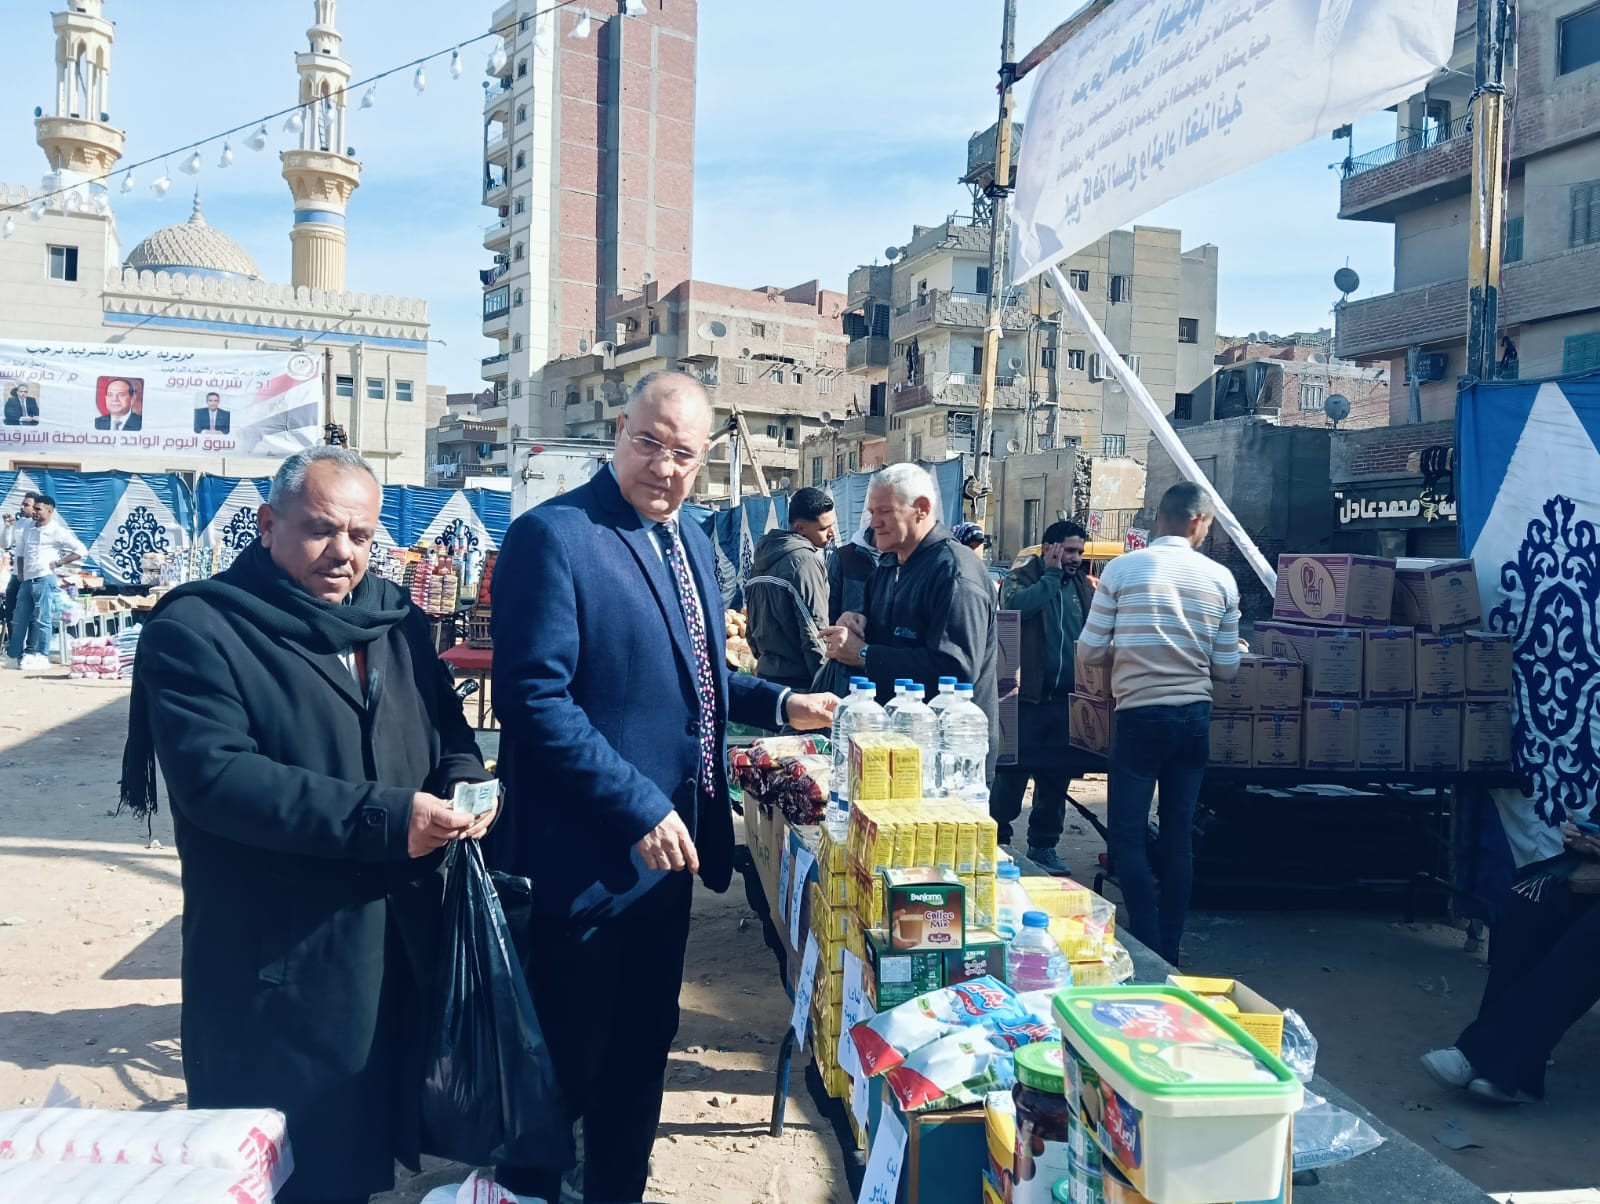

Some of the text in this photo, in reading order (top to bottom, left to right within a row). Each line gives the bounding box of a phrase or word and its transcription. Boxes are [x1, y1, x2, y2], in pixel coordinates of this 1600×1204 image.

[52, 433, 117, 447] بمحافظة
[119, 435, 160, 448] الواحد
[162, 437, 199, 450] اليوم
[202, 438, 236, 451] سوق
[1339, 499, 1377, 524] عادل
[1378, 499, 1420, 518] محمد
[925, 910, 955, 921] Coffee
[930, 920, 950, 929] Mix
